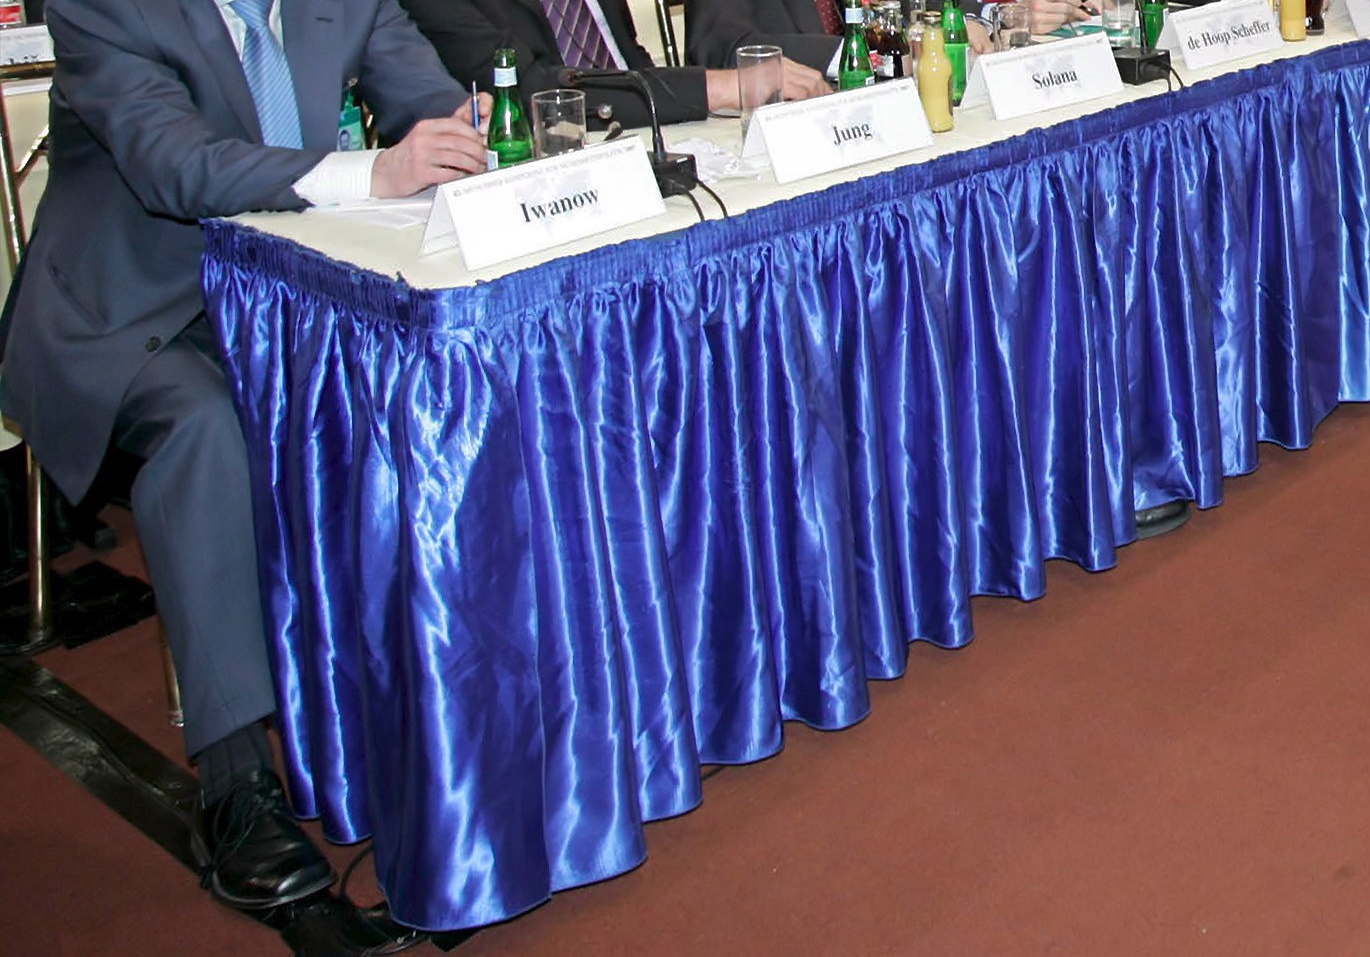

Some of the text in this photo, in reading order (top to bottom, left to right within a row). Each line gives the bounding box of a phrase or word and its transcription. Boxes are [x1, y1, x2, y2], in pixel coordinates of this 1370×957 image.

[1187, 20, 1271, 50] de Hoop Scheffer
[1031, 69, 1078, 89] Solana
[832, 122, 873, 146] Jung
[520, 188, 599, 223] Iwanow
